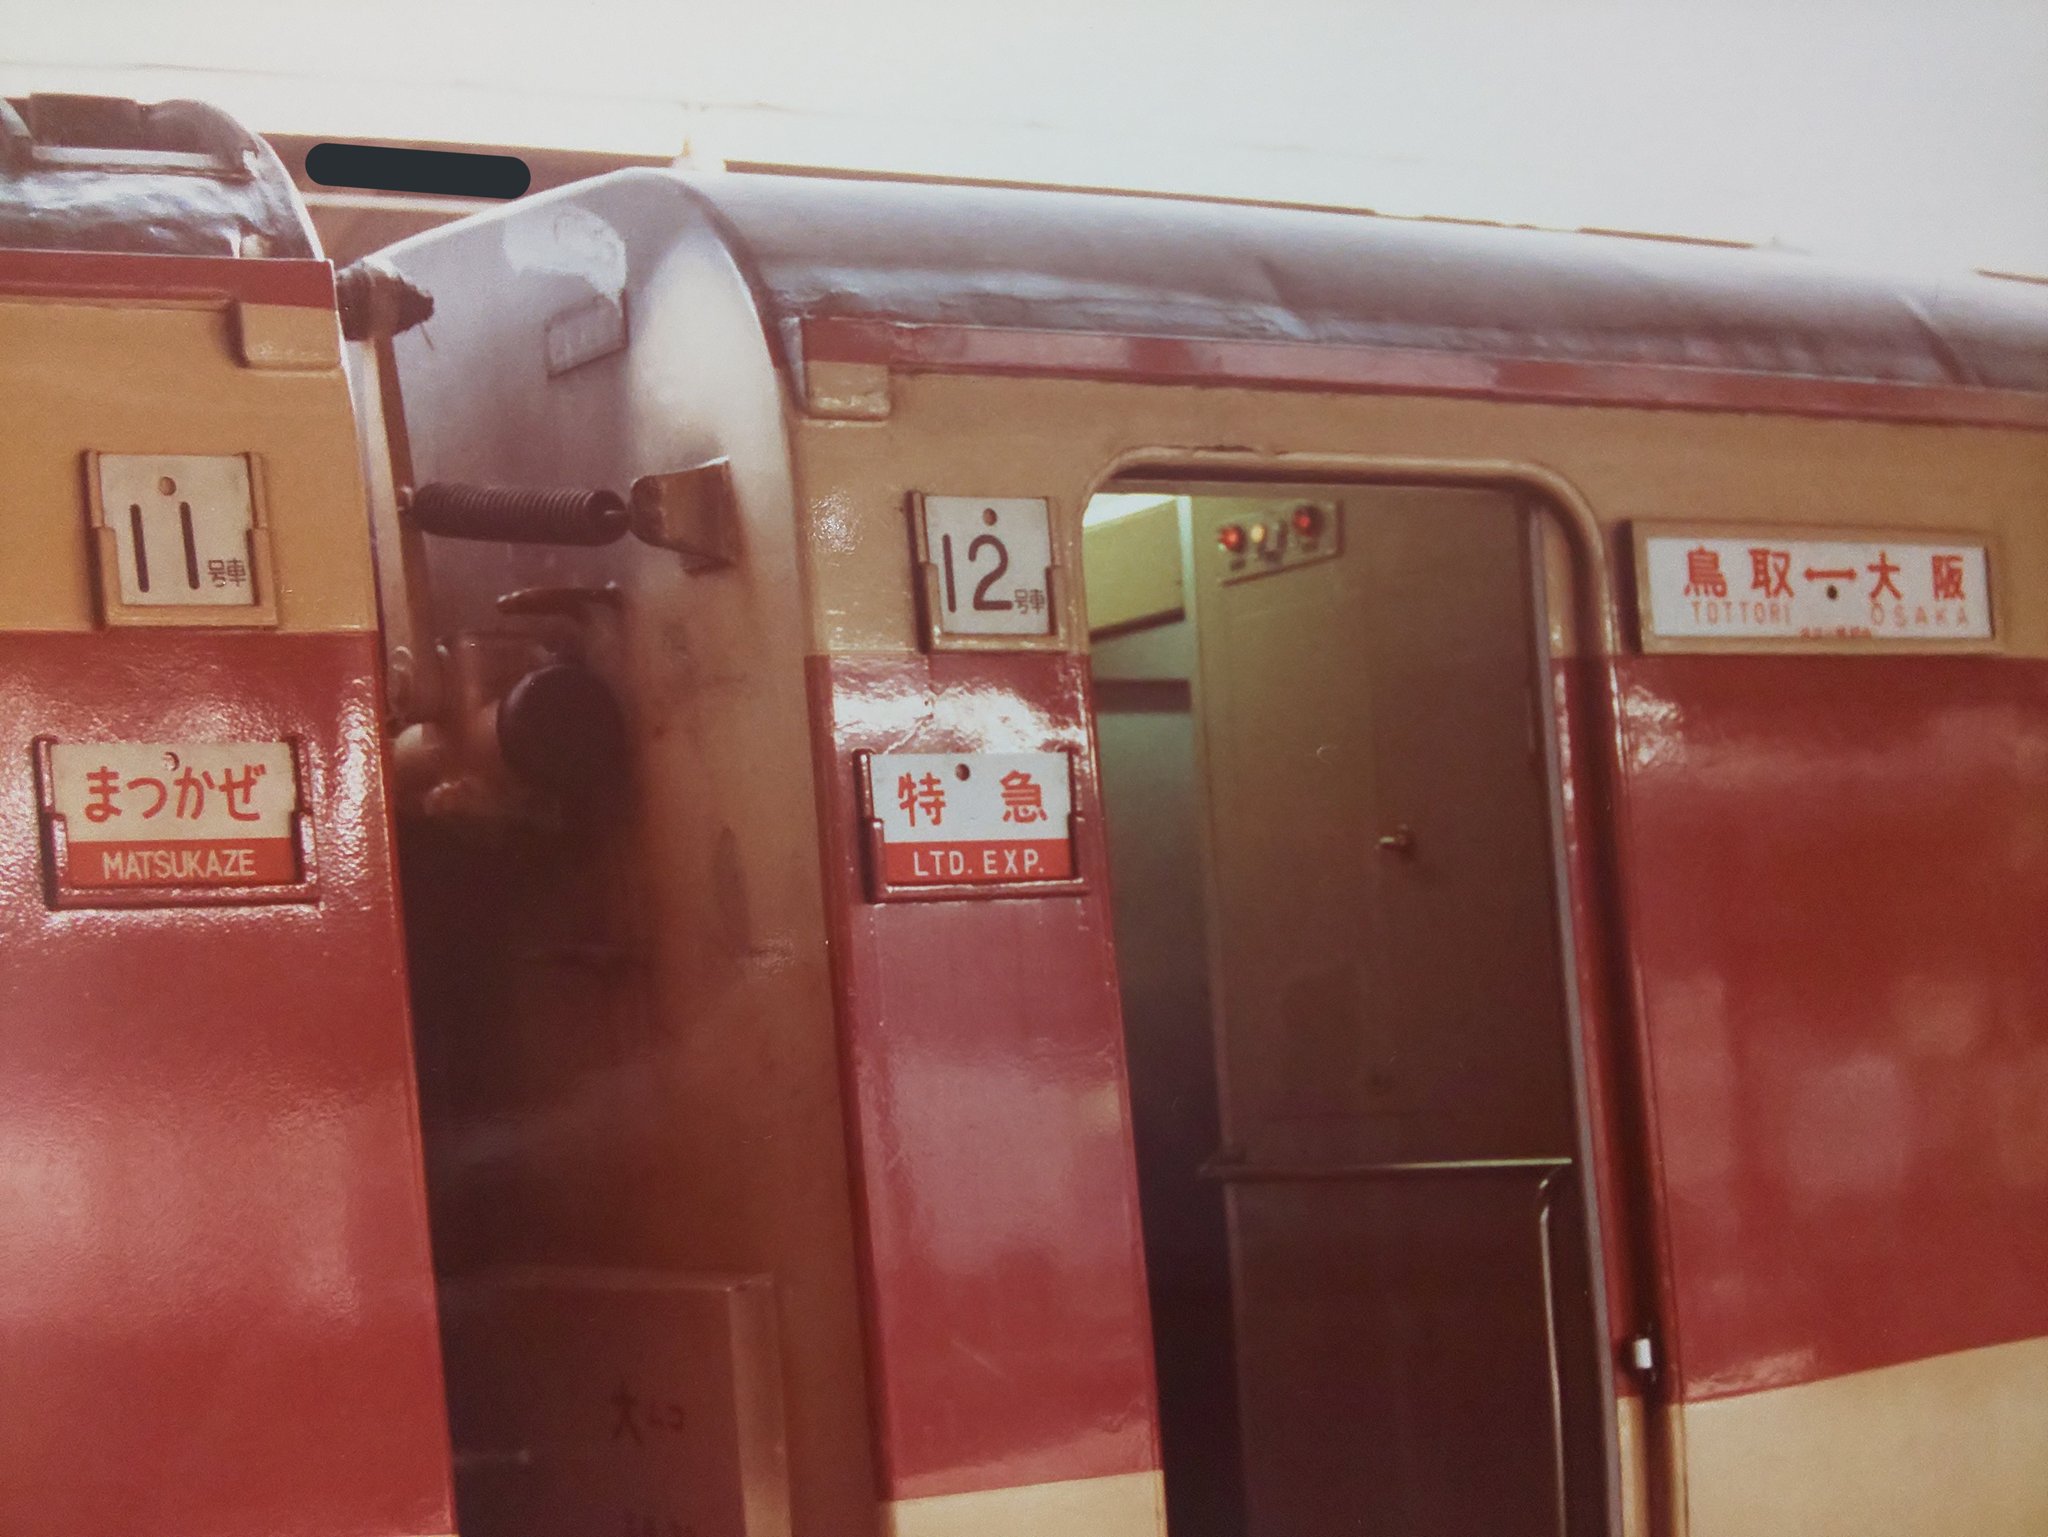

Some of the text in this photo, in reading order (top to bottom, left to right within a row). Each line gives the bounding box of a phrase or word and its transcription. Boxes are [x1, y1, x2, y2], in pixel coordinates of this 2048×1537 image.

[1684, 546, 1965, 600] 鳥取 大阪
[1691, 601, 1968, 627] TOTTORI OSAKA
[86, 765, 267, 822] まつかぜ
[898, 770, 1047, 827] 特急
[103, 849, 256, 879] MATSUKAZE
[913, 850, 1044, 876] LTD. EXP.
